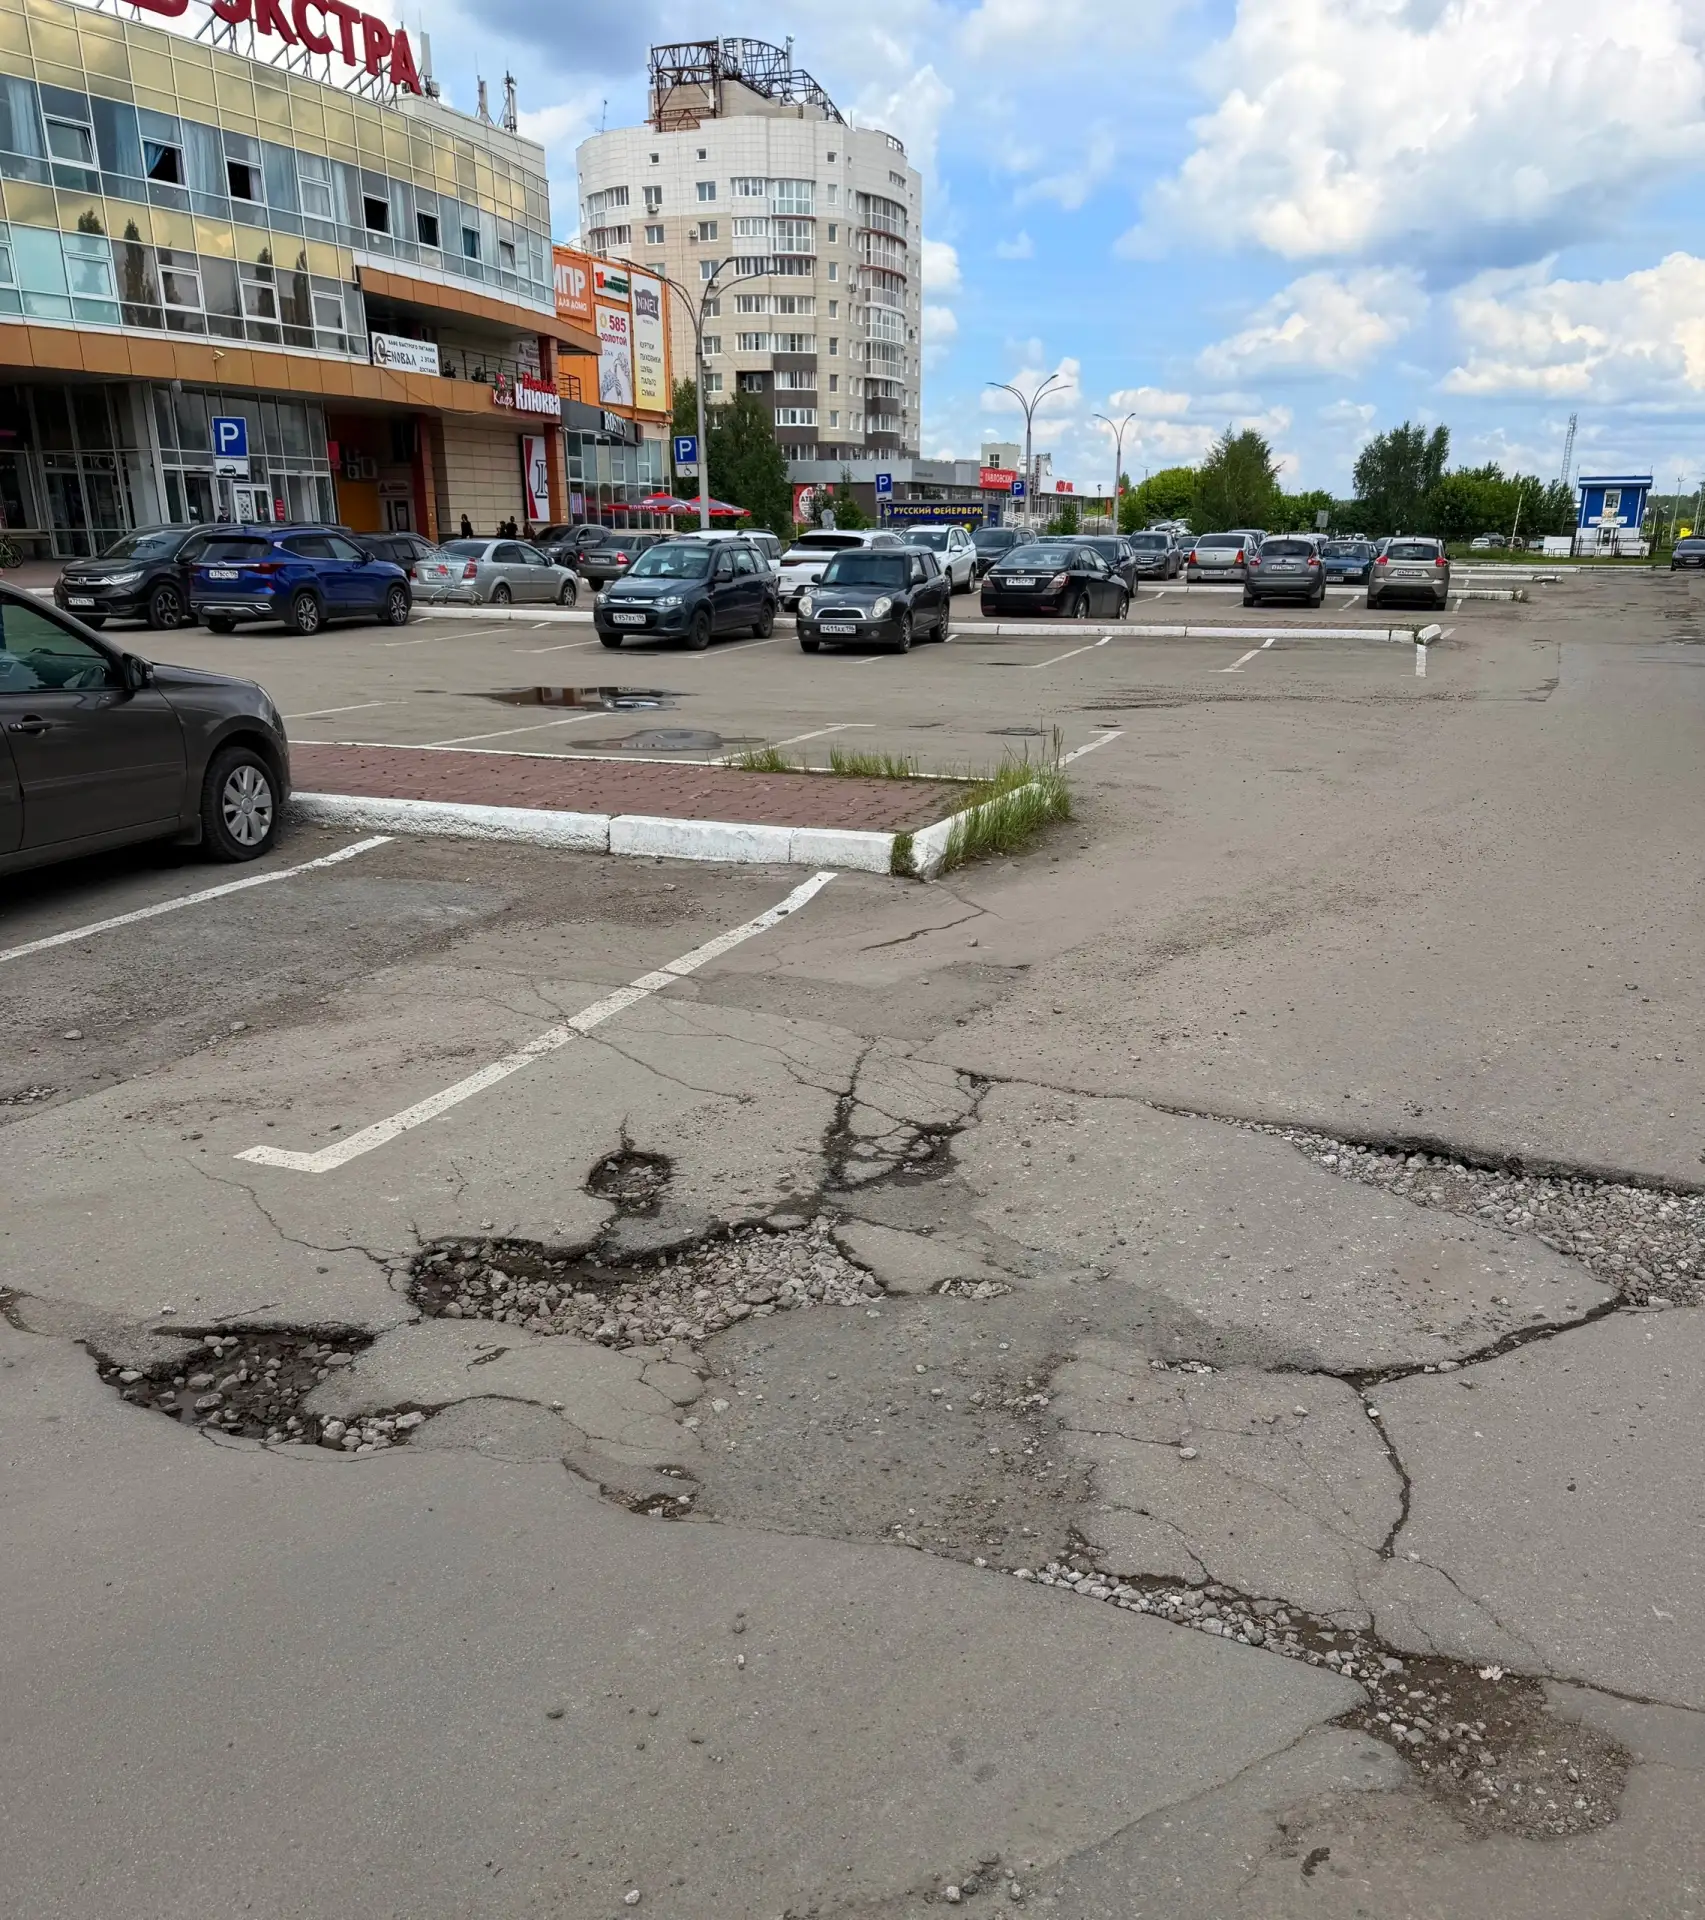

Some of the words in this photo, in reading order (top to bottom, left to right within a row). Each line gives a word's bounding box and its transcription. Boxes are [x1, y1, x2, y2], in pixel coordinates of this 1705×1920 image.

[570, 301, 587, 312] ДОМА
[609, 314, 627, 333] 585
[600, 332, 628, 347] ЗОЛОТОЙ
[640, 341, 655, 350] КУРТКИ
[424, 356, 436, 364] ЭТАЖ
[640, 353, 662, 363] ПУХОВИКИ
[641, 377, 656, 386] ПАЛЬТО
[220, 422, 239, 452] P
[679, 440, 692, 460] P
[879, 476, 889, 491] P
[893, 505, 931, 515] РУССКИЙ
[932, 505, 983, 515] ФЕЙЕРВЕРК
